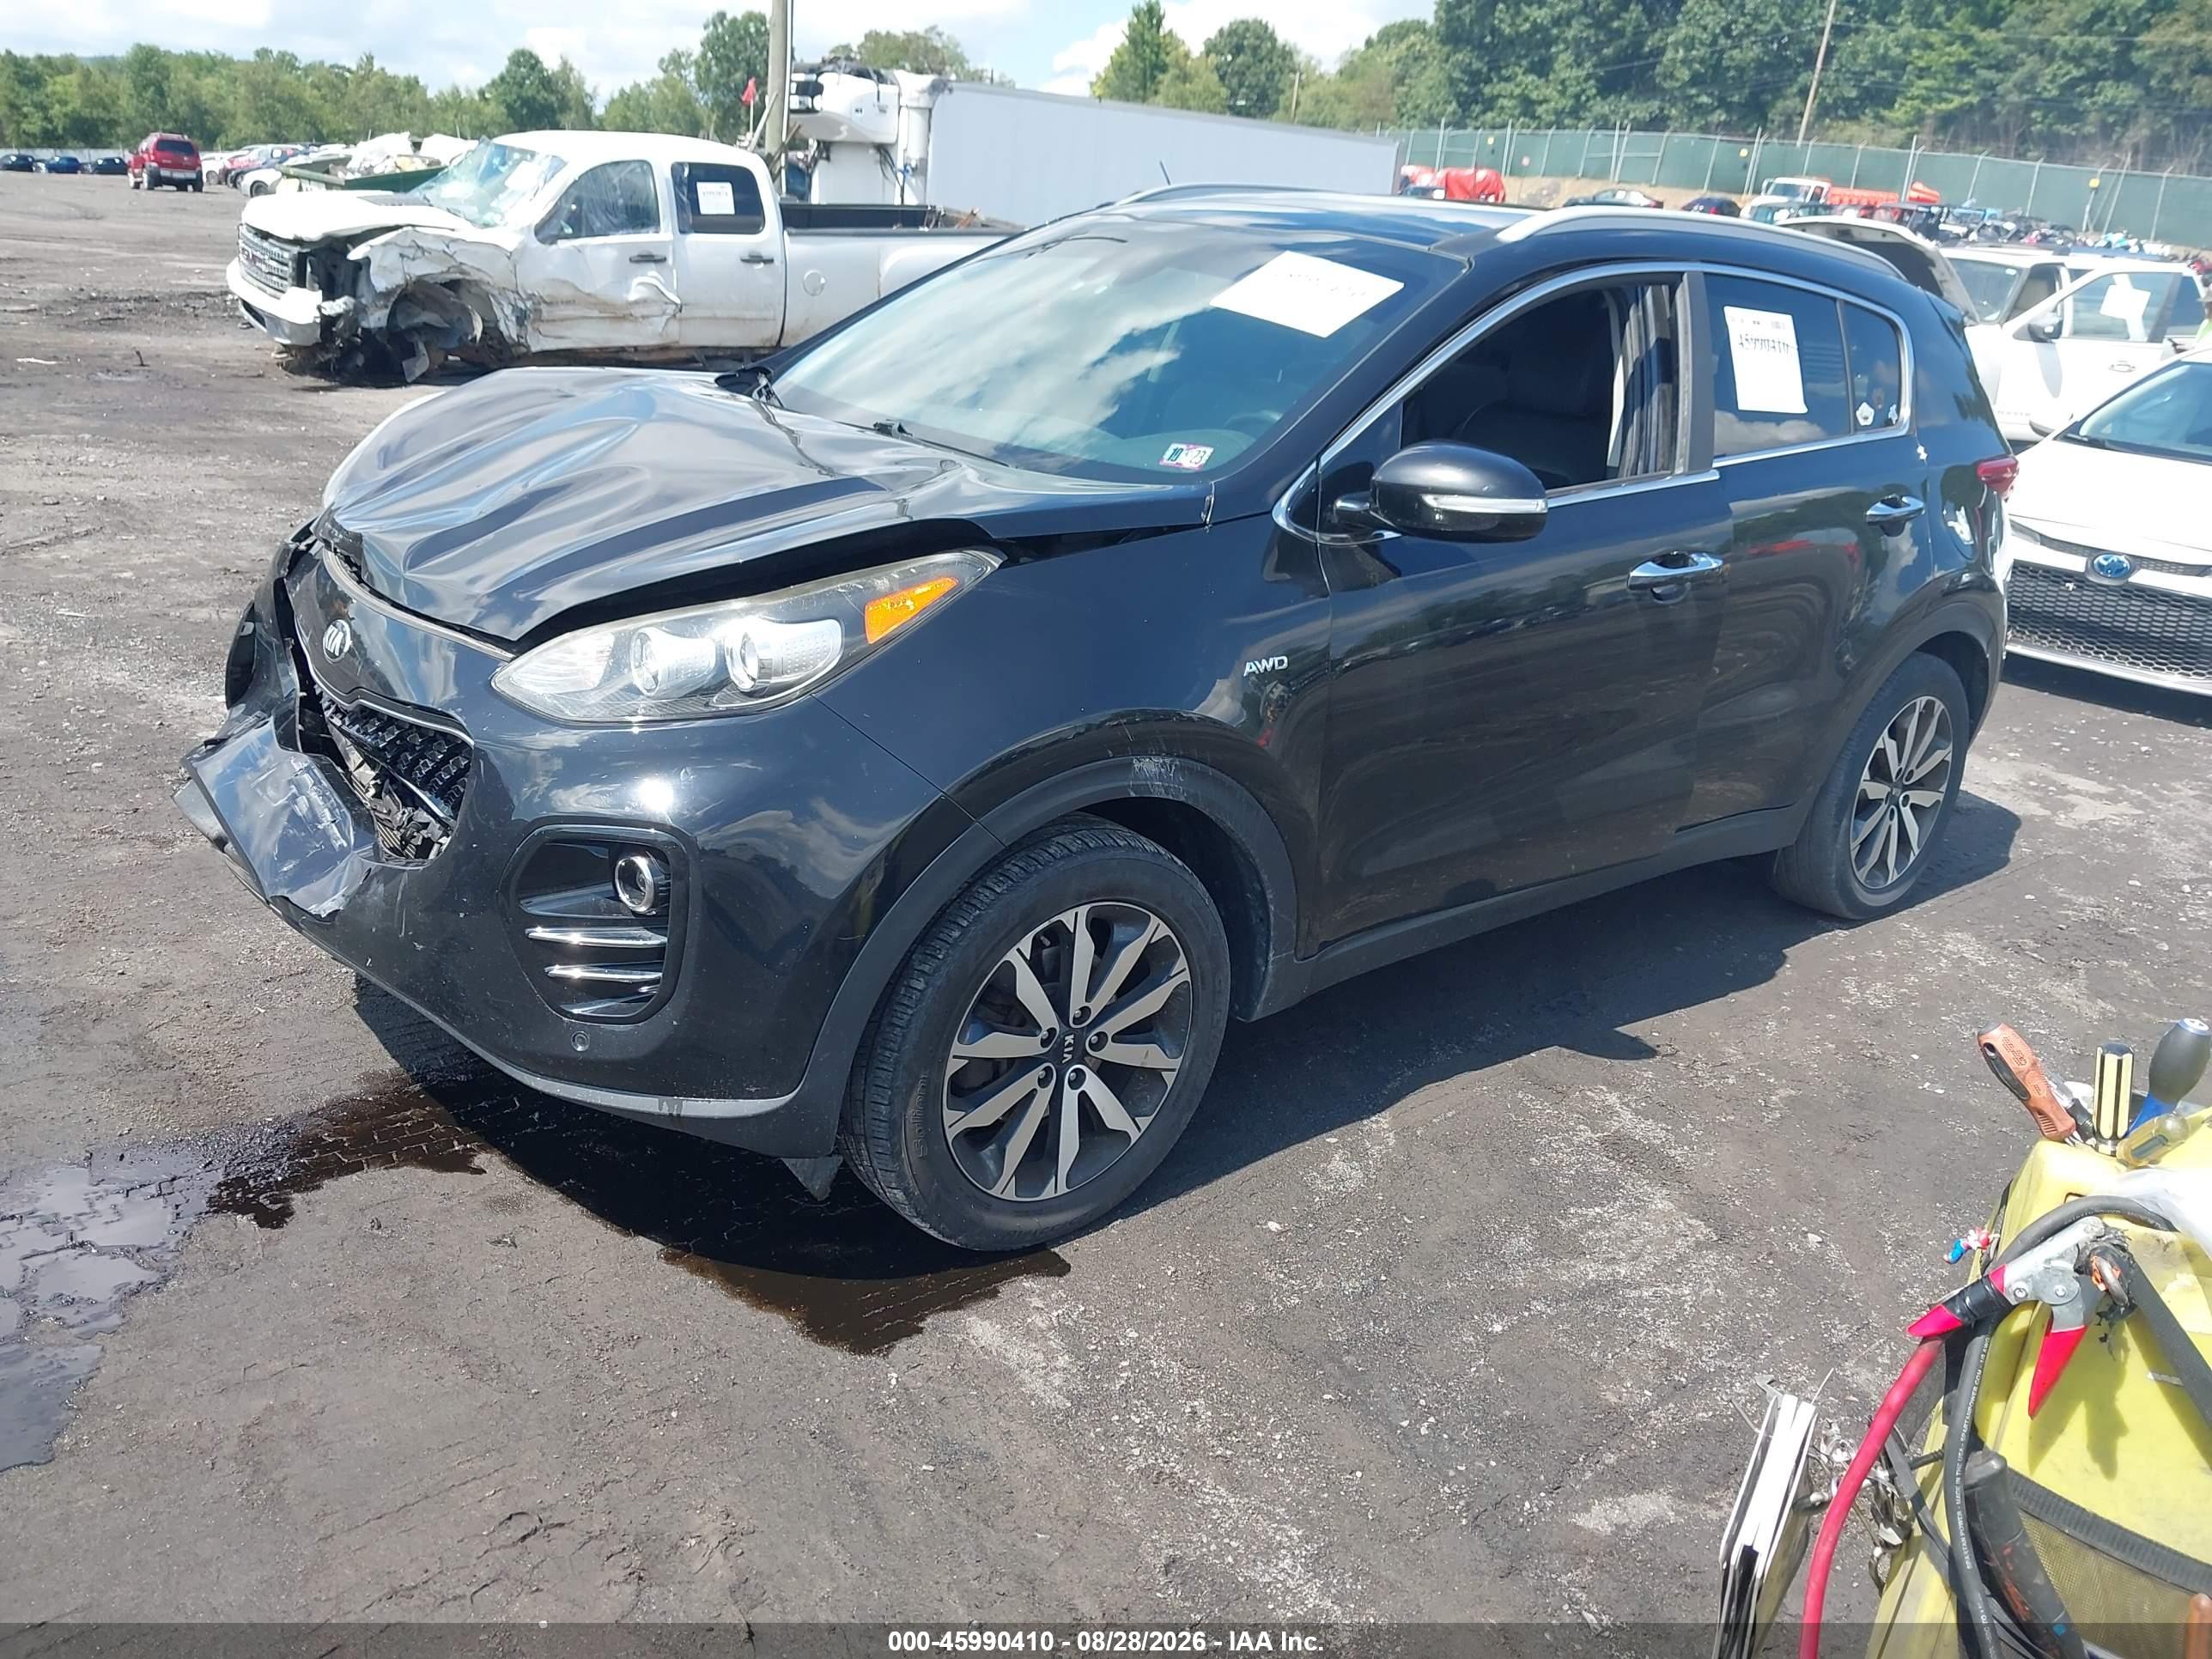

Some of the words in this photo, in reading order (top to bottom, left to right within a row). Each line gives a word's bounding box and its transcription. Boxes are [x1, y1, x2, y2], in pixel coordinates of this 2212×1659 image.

[1167, 447, 1183, 462] 10
[1189, 449, 1206, 465] 23
[1243, 655, 1289, 677] AWD
[1062, 1034, 1074, 1064] KIA
[1960, 1369, 1983, 1442] SPARTANPOWER.COM
[1956, 1510, 1966, 1536] POWER
[1960, 1536, 1973, 1571] SPARTAN
